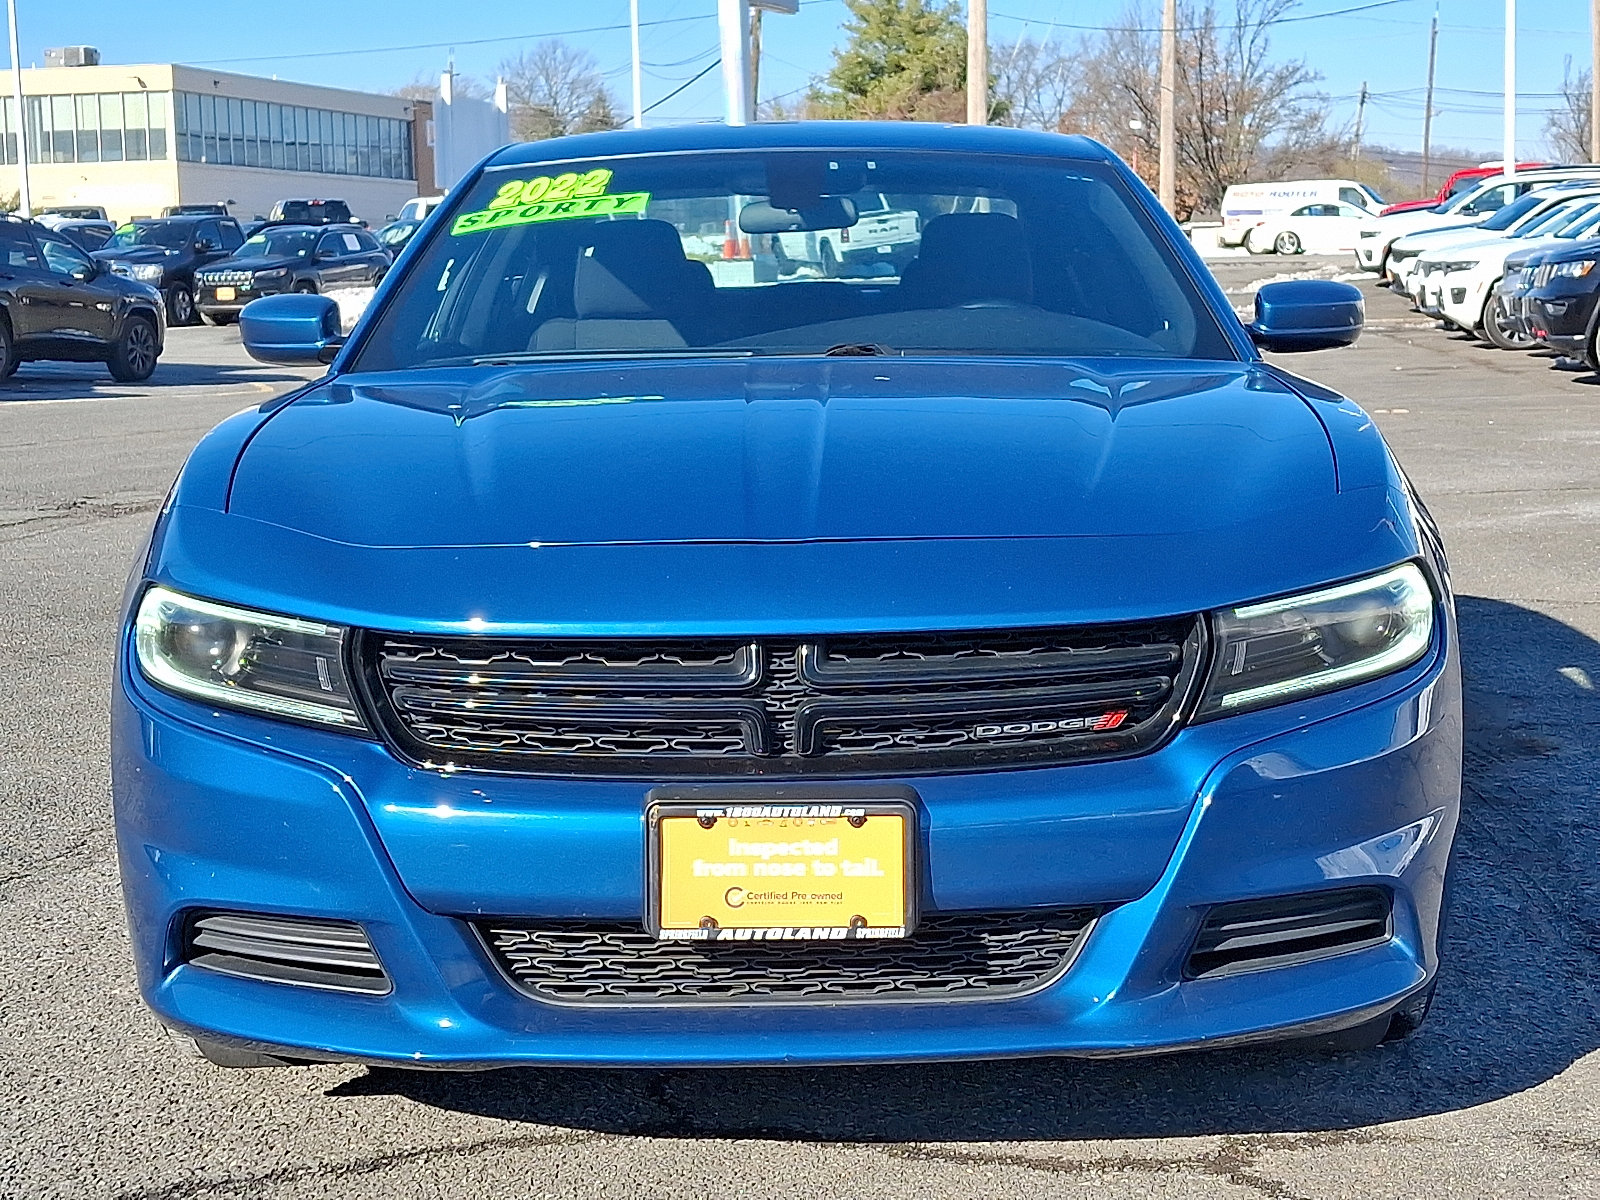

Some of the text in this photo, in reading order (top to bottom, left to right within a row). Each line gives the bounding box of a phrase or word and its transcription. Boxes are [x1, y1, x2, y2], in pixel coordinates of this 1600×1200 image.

[489, 168, 613, 210] 2022
[458, 195, 639, 228] SPORTY
[976, 717, 1109, 737] DODGE
[728, 837, 839, 860] Inspected
[693, 857, 885, 877] from nose to tail.
[746, 891, 788, 900] Certified
[717, 928, 848, 940] AUTOLAND
